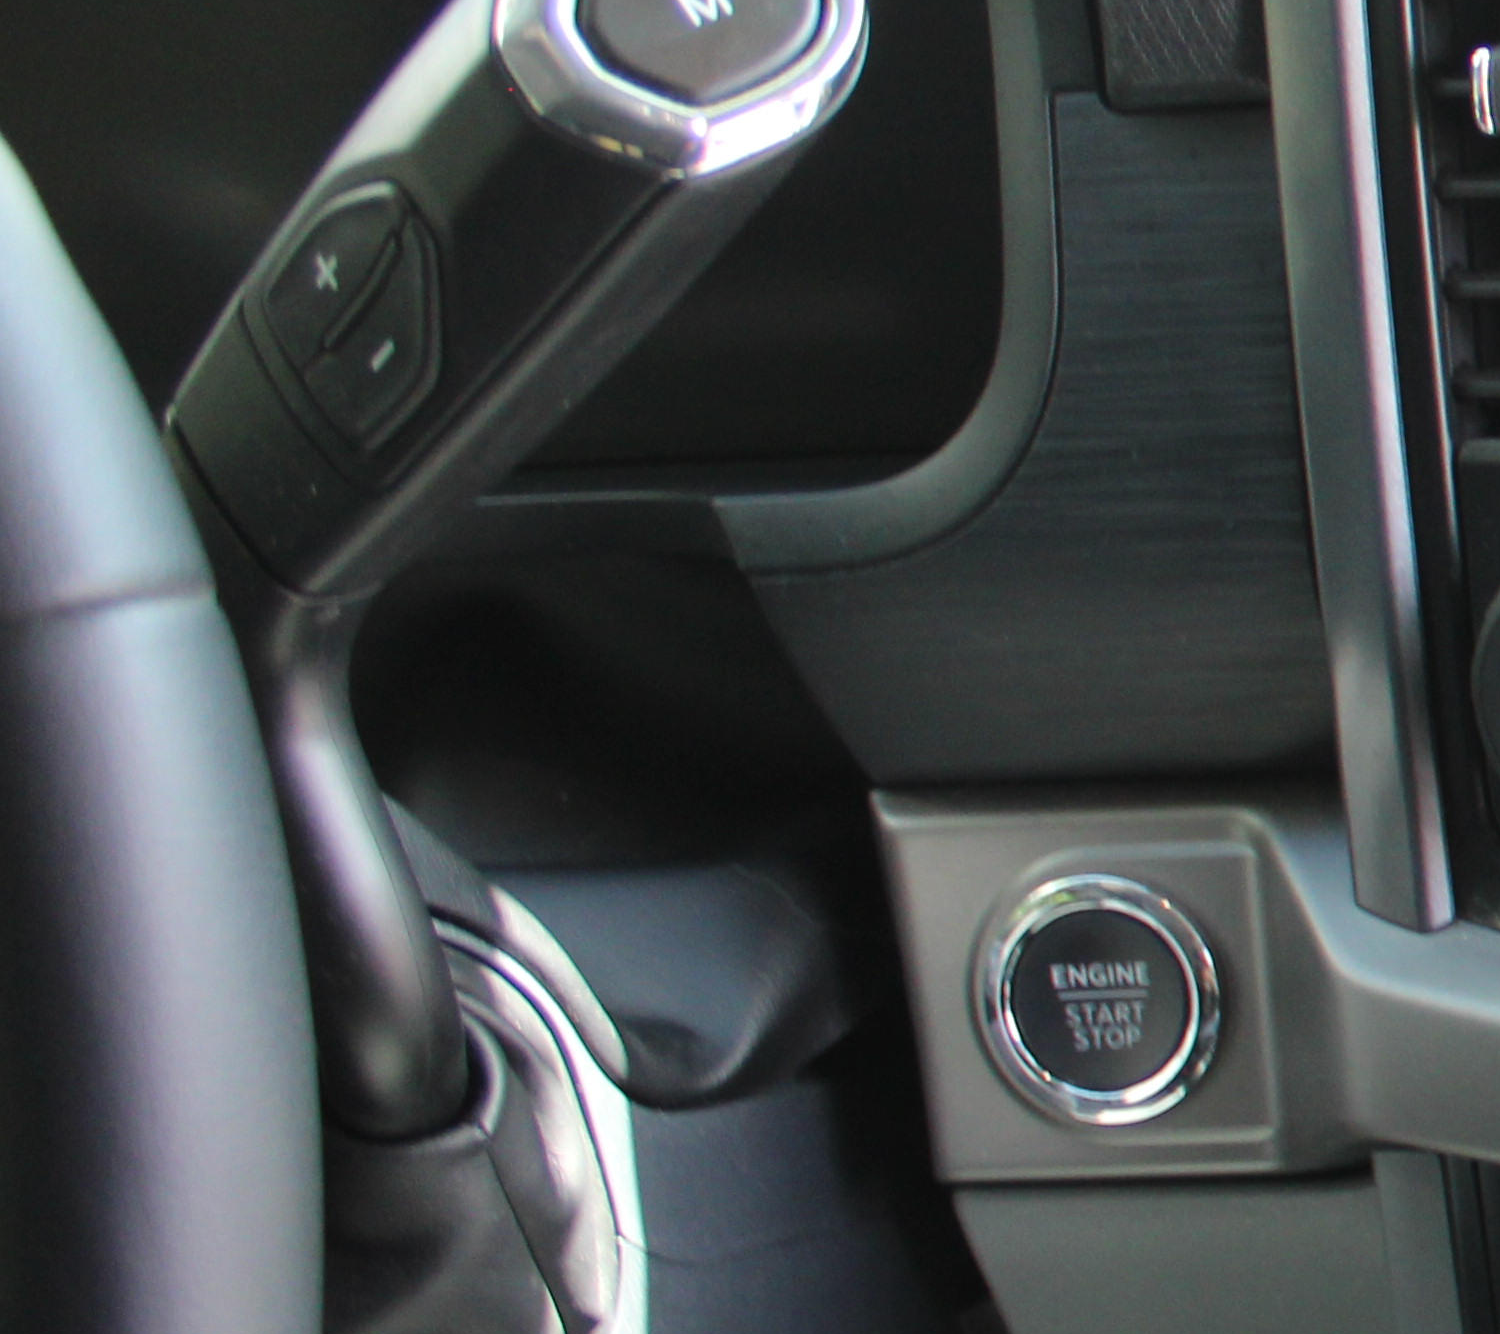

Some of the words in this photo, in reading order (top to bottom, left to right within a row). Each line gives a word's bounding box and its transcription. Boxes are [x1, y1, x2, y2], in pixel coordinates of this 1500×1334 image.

[1051, 961, 1150, 989] ENGINE
[1065, 1001, 1145, 1026] START
[1074, 1025, 1142, 1052] STOP
